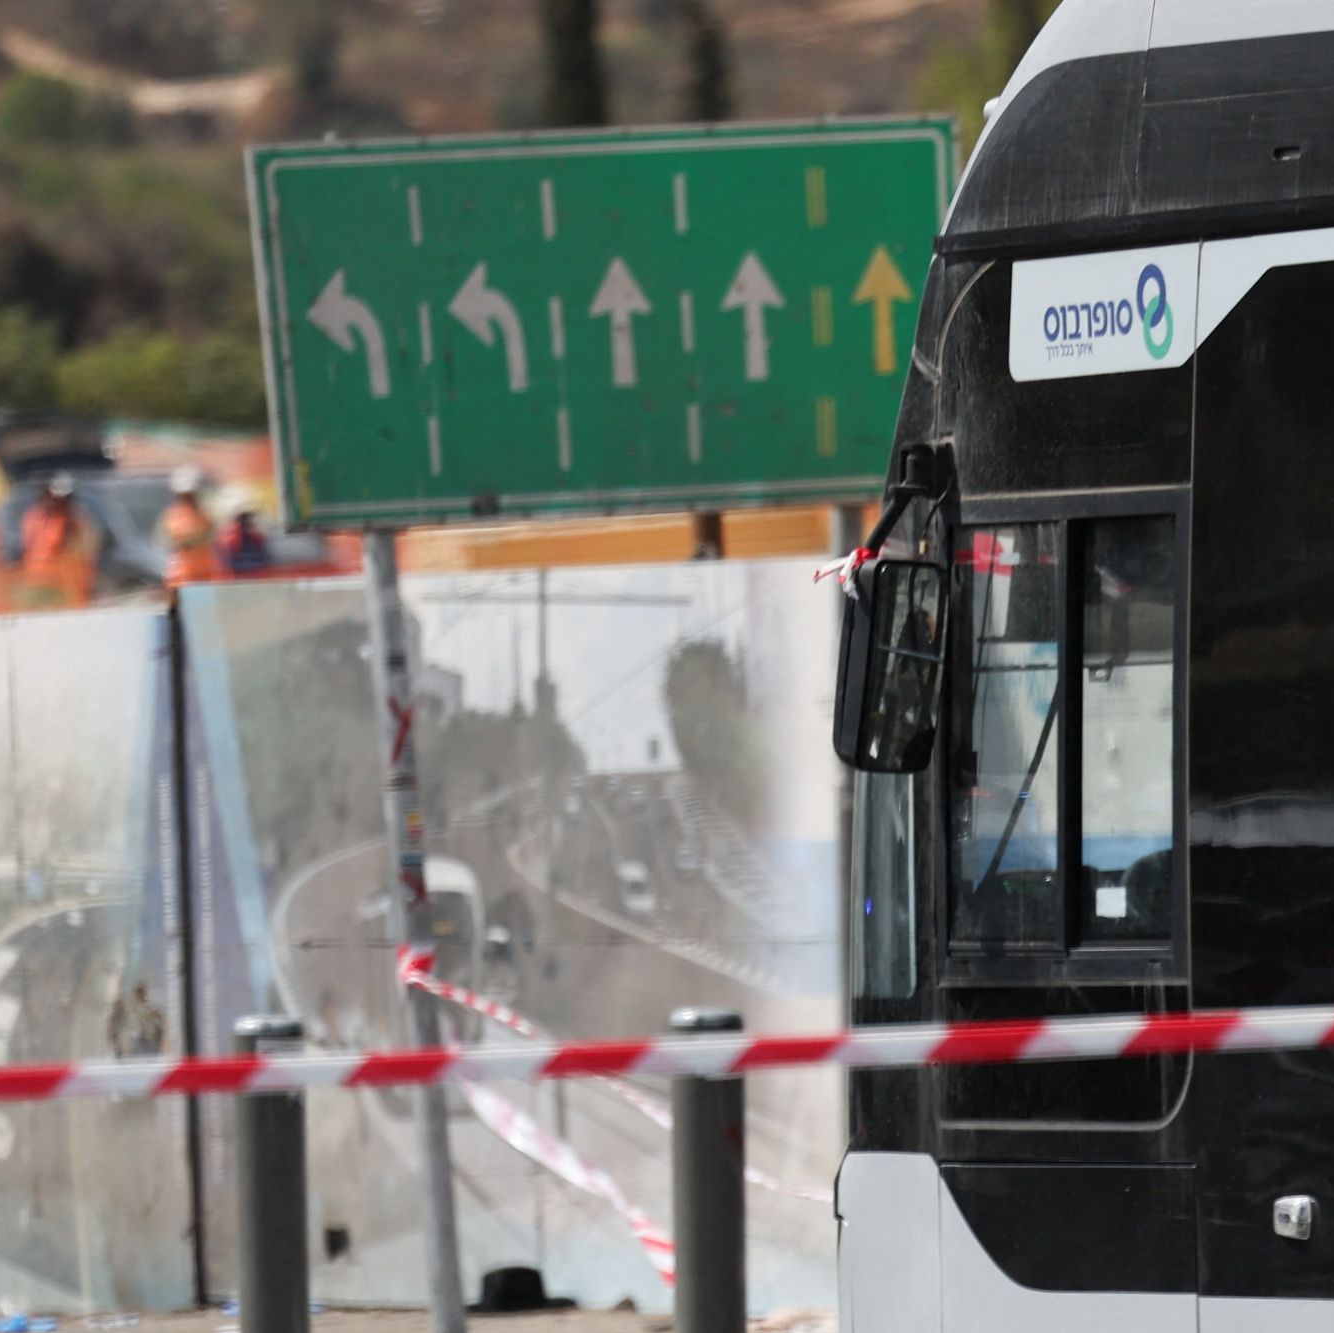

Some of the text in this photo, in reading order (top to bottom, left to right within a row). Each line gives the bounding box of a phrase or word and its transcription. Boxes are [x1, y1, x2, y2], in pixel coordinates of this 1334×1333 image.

[1043, 299, 1133, 342] סופרבוס
[1046, 343, 1093, 361] איתך בכל דרך
